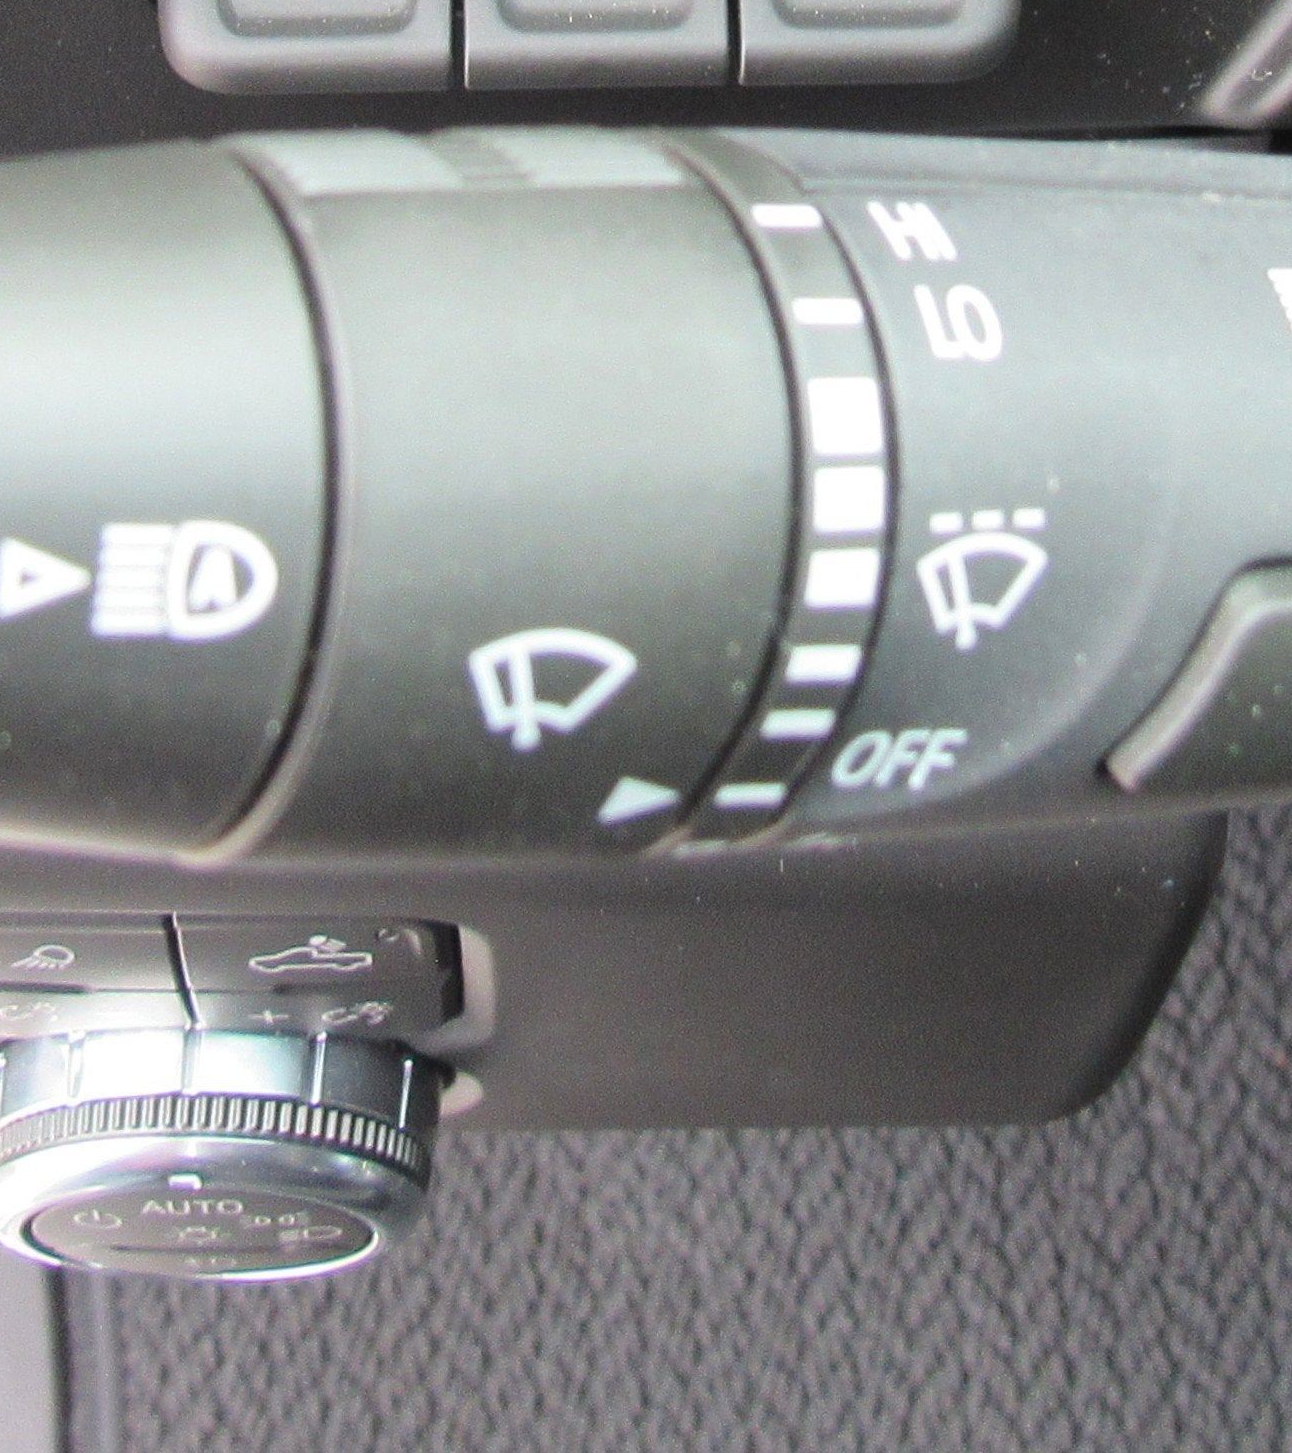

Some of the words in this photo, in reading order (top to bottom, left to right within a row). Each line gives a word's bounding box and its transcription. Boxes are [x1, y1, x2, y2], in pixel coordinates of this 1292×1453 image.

[868, 201, 957, 261] HI
[914, 284, 1003, 361] LO
[830, 727, 967, 791] OFF
[140, 1199, 244, 1216] AUTO
